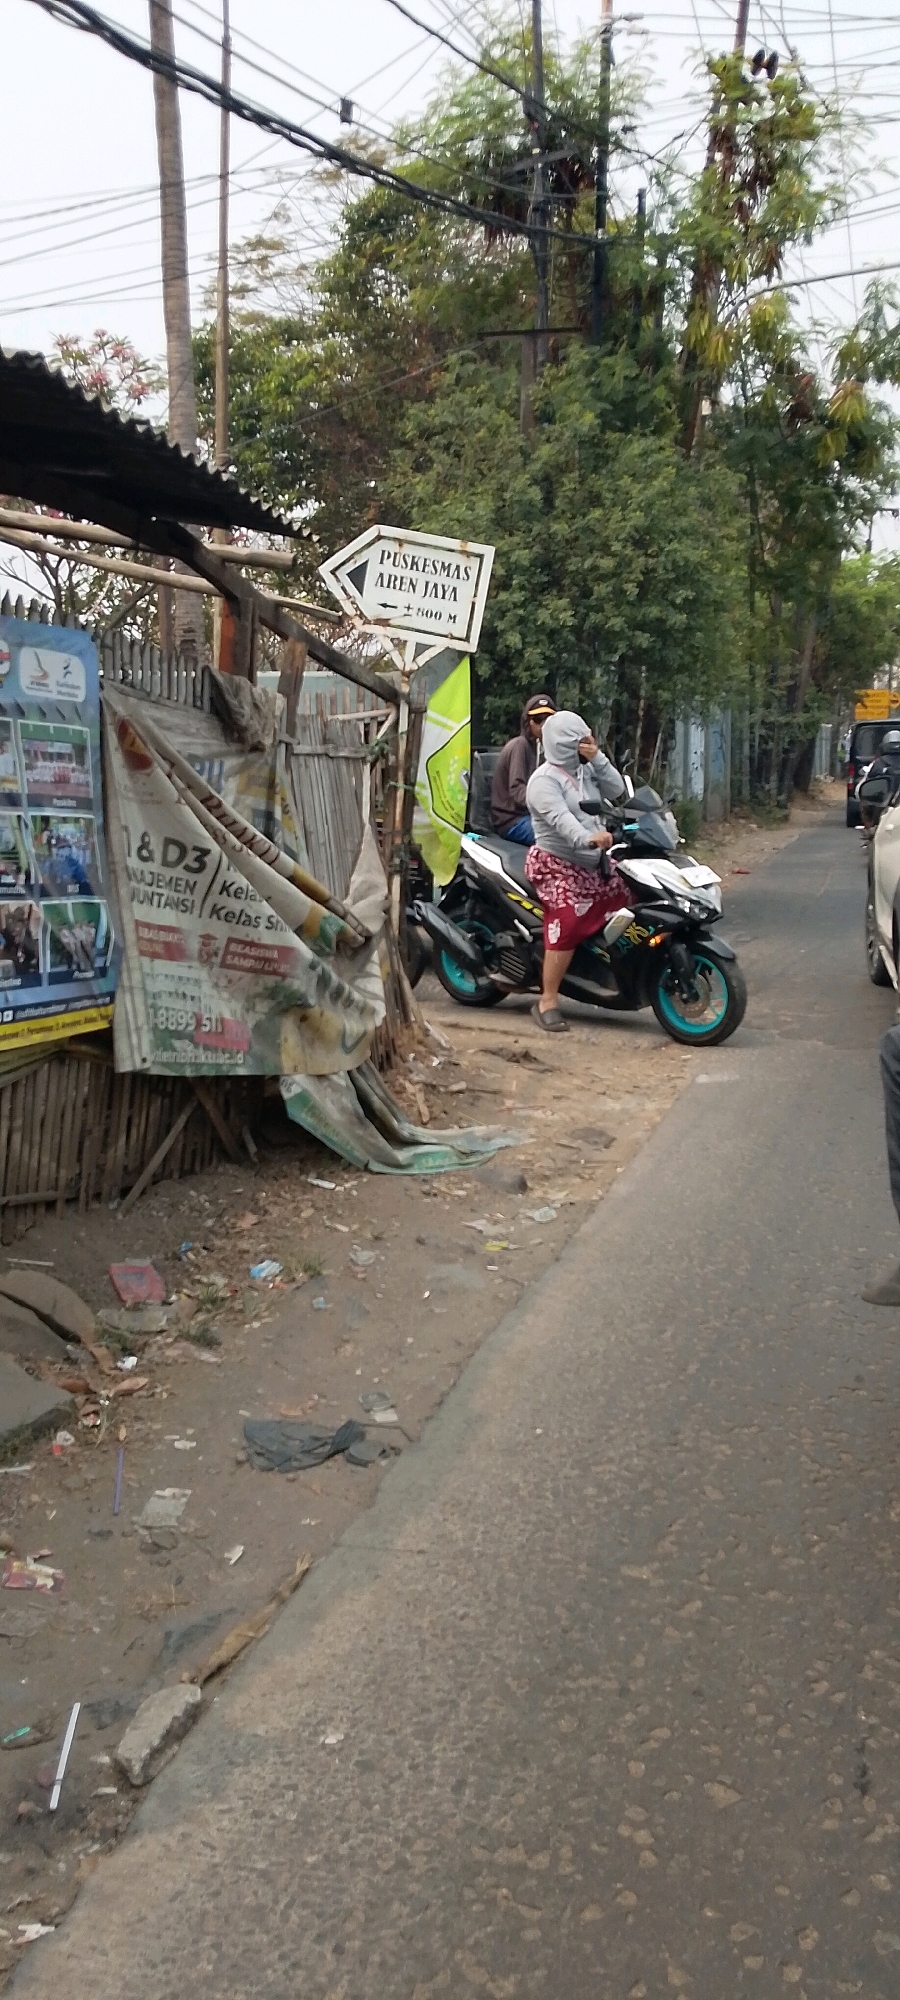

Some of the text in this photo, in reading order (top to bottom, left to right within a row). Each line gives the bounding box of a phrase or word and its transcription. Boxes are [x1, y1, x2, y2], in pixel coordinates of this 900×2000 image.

[379, 549, 471, 581] PUSKESMAS
[374, 572, 458, 602] AREN JAYA
[447, 612, 458, 624] M
[137, 831, 155, 863] &
[162, 836, 212, 874] D3
[219, 880, 264, 902] Kela
[209, 903, 262, 929] Kelas
